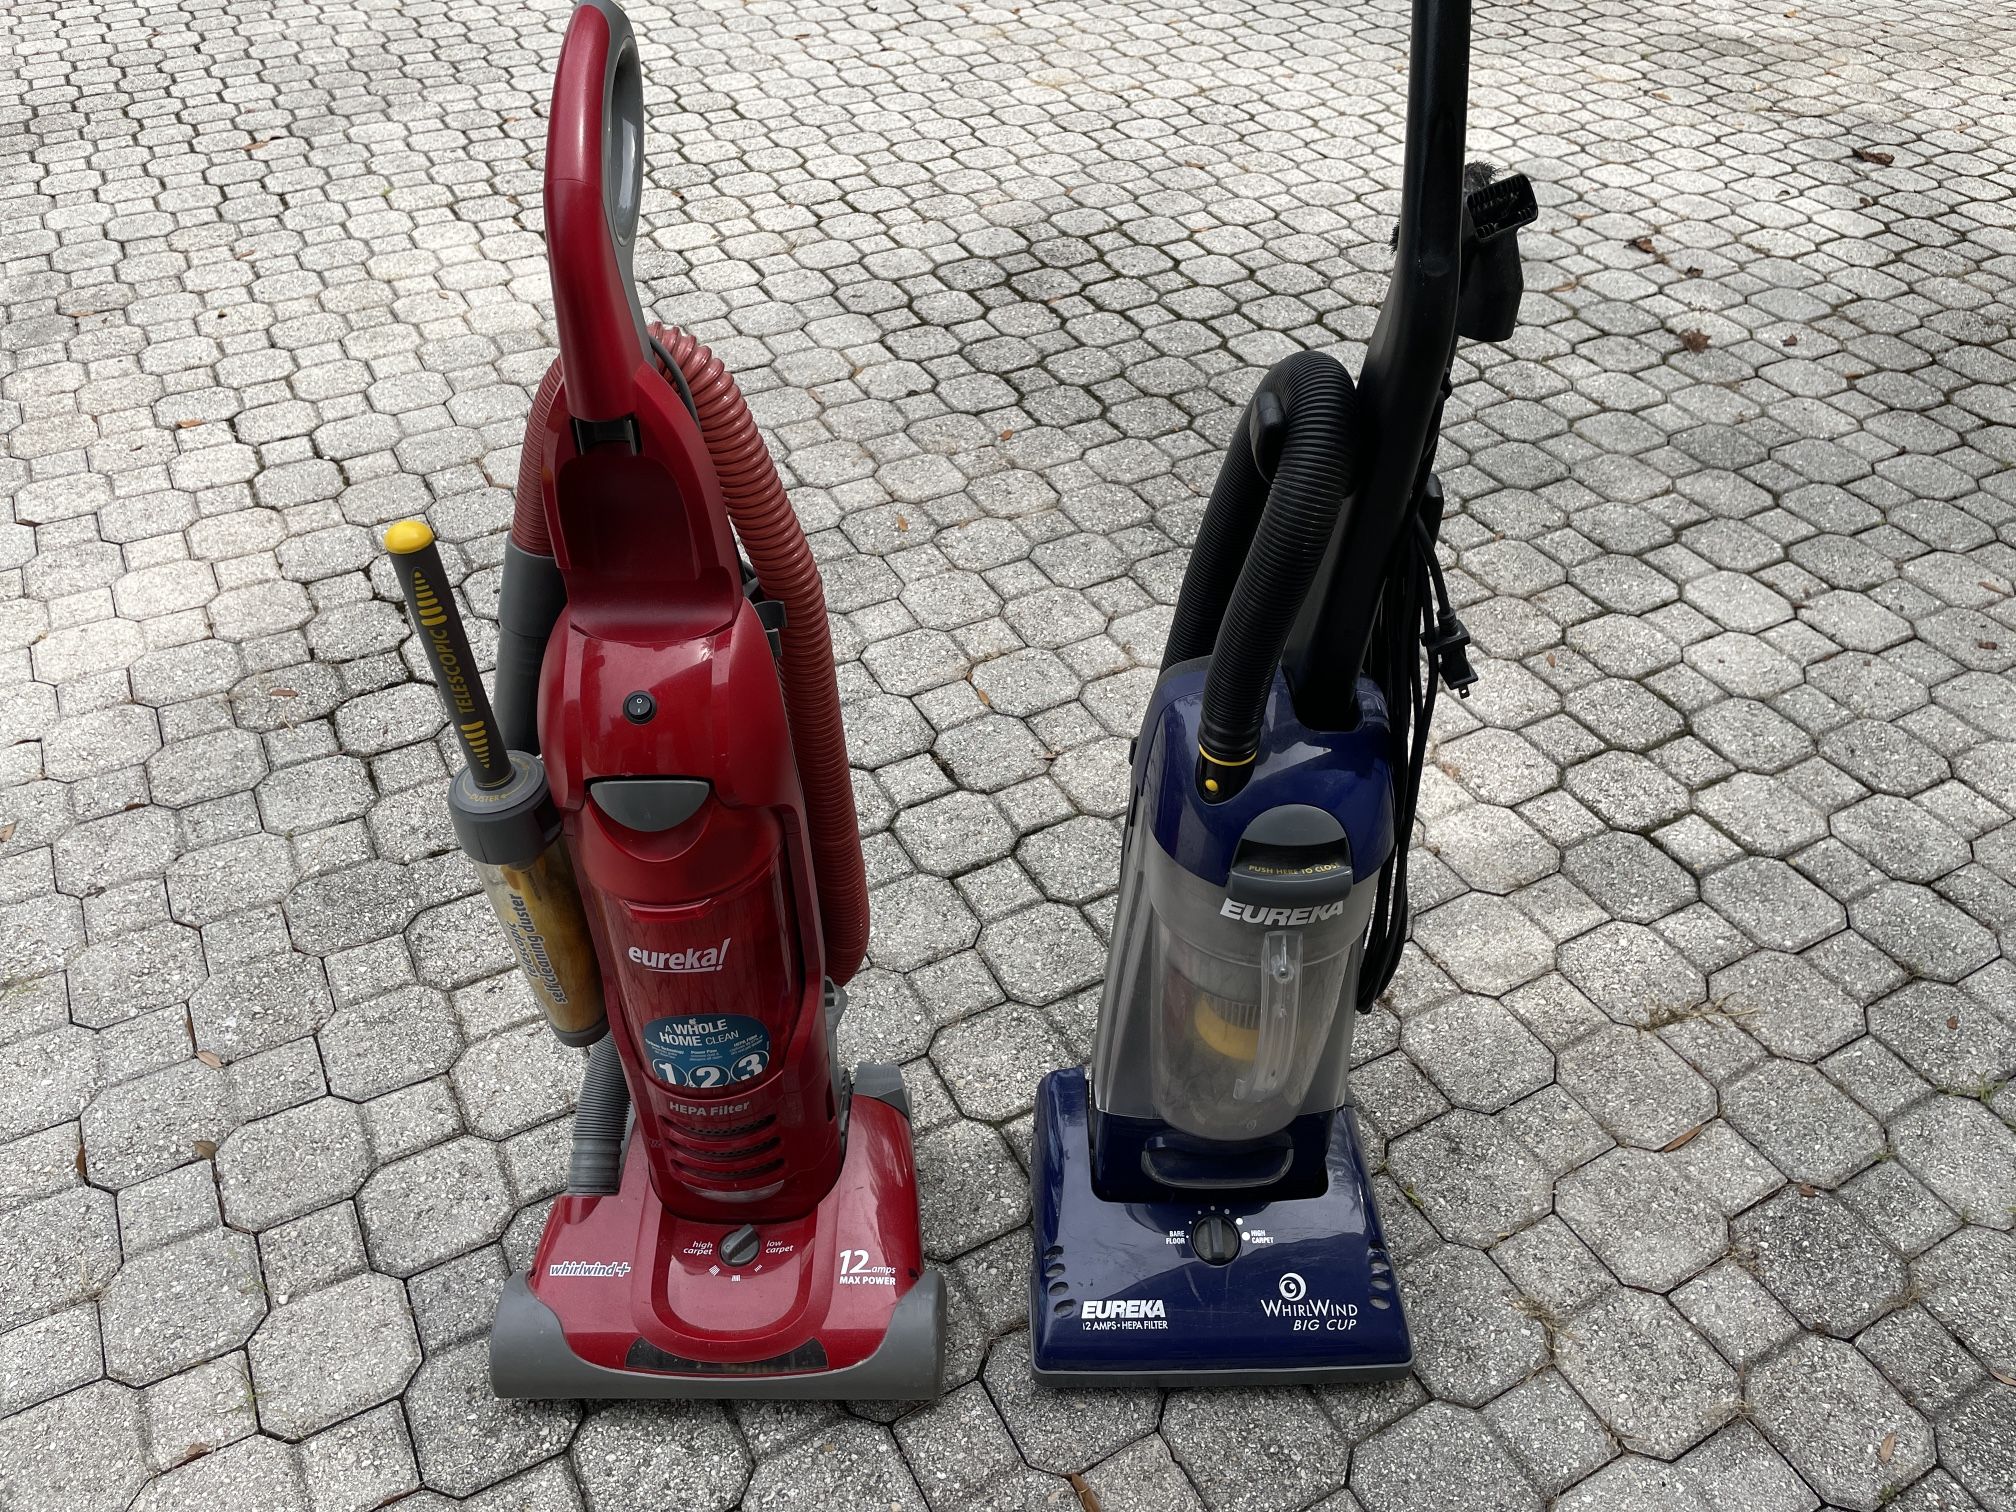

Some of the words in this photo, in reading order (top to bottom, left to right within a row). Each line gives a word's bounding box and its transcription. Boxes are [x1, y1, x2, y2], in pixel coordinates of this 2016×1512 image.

[429, 628, 476, 714] TELESCOPIC
[468, 792, 500, 804] DUSTER
[1248, 864, 1274, 874] PUSH
[1275, 868, 1298, 876] HERE
[1301, 867, 1313, 875] TO
[508, 893, 537, 934] duster
[1219, 897, 1345, 927] EUREKA
[506, 920, 540, 979] telescopic
[628, 937, 731, 972] eureka!
[664, 1025, 673, 1034] A
[673, 1018, 728, 1035] WHOLE
[658, 1031, 703, 1047] HOME
[705, 1029, 739, 1046] CLEAN
[658, 1062, 677, 1085] 1
[696, 1066, 724, 1088] 2
[738, 1053, 763, 1081] 3
[669, 1100, 706, 1117] HEPA
[709, 1100, 751, 1117] Filter
[1250, 1229, 1266, 1237] HIGH
[692, 1240, 713, 1249] high
[766, 1239, 783, 1248] low
[1165, 1237, 1186, 1245] FLOOR
[1251, 1236, 1274, 1244] CARPET
[683, 1246, 713, 1256] carpet
[765, 1244, 794, 1255] carpet
[839, 1249, 872, 1275] 12
[871, 1264, 896, 1276] amps
[839, 1276, 861, 1286] MAX
[862, 1276, 896, 1286] POWER
[1081, 1299, 1166, 1319] EUREKA
[1092, 1321, 1117, 1331] AMPS
[1121, 1320, 1143, 1330] HEPA
[1143, 1320, 1169, 1330] FILTER
[1292, 1319, 1320, 1332] BIG
[1326, 1319, 1357, 1331] CUP
